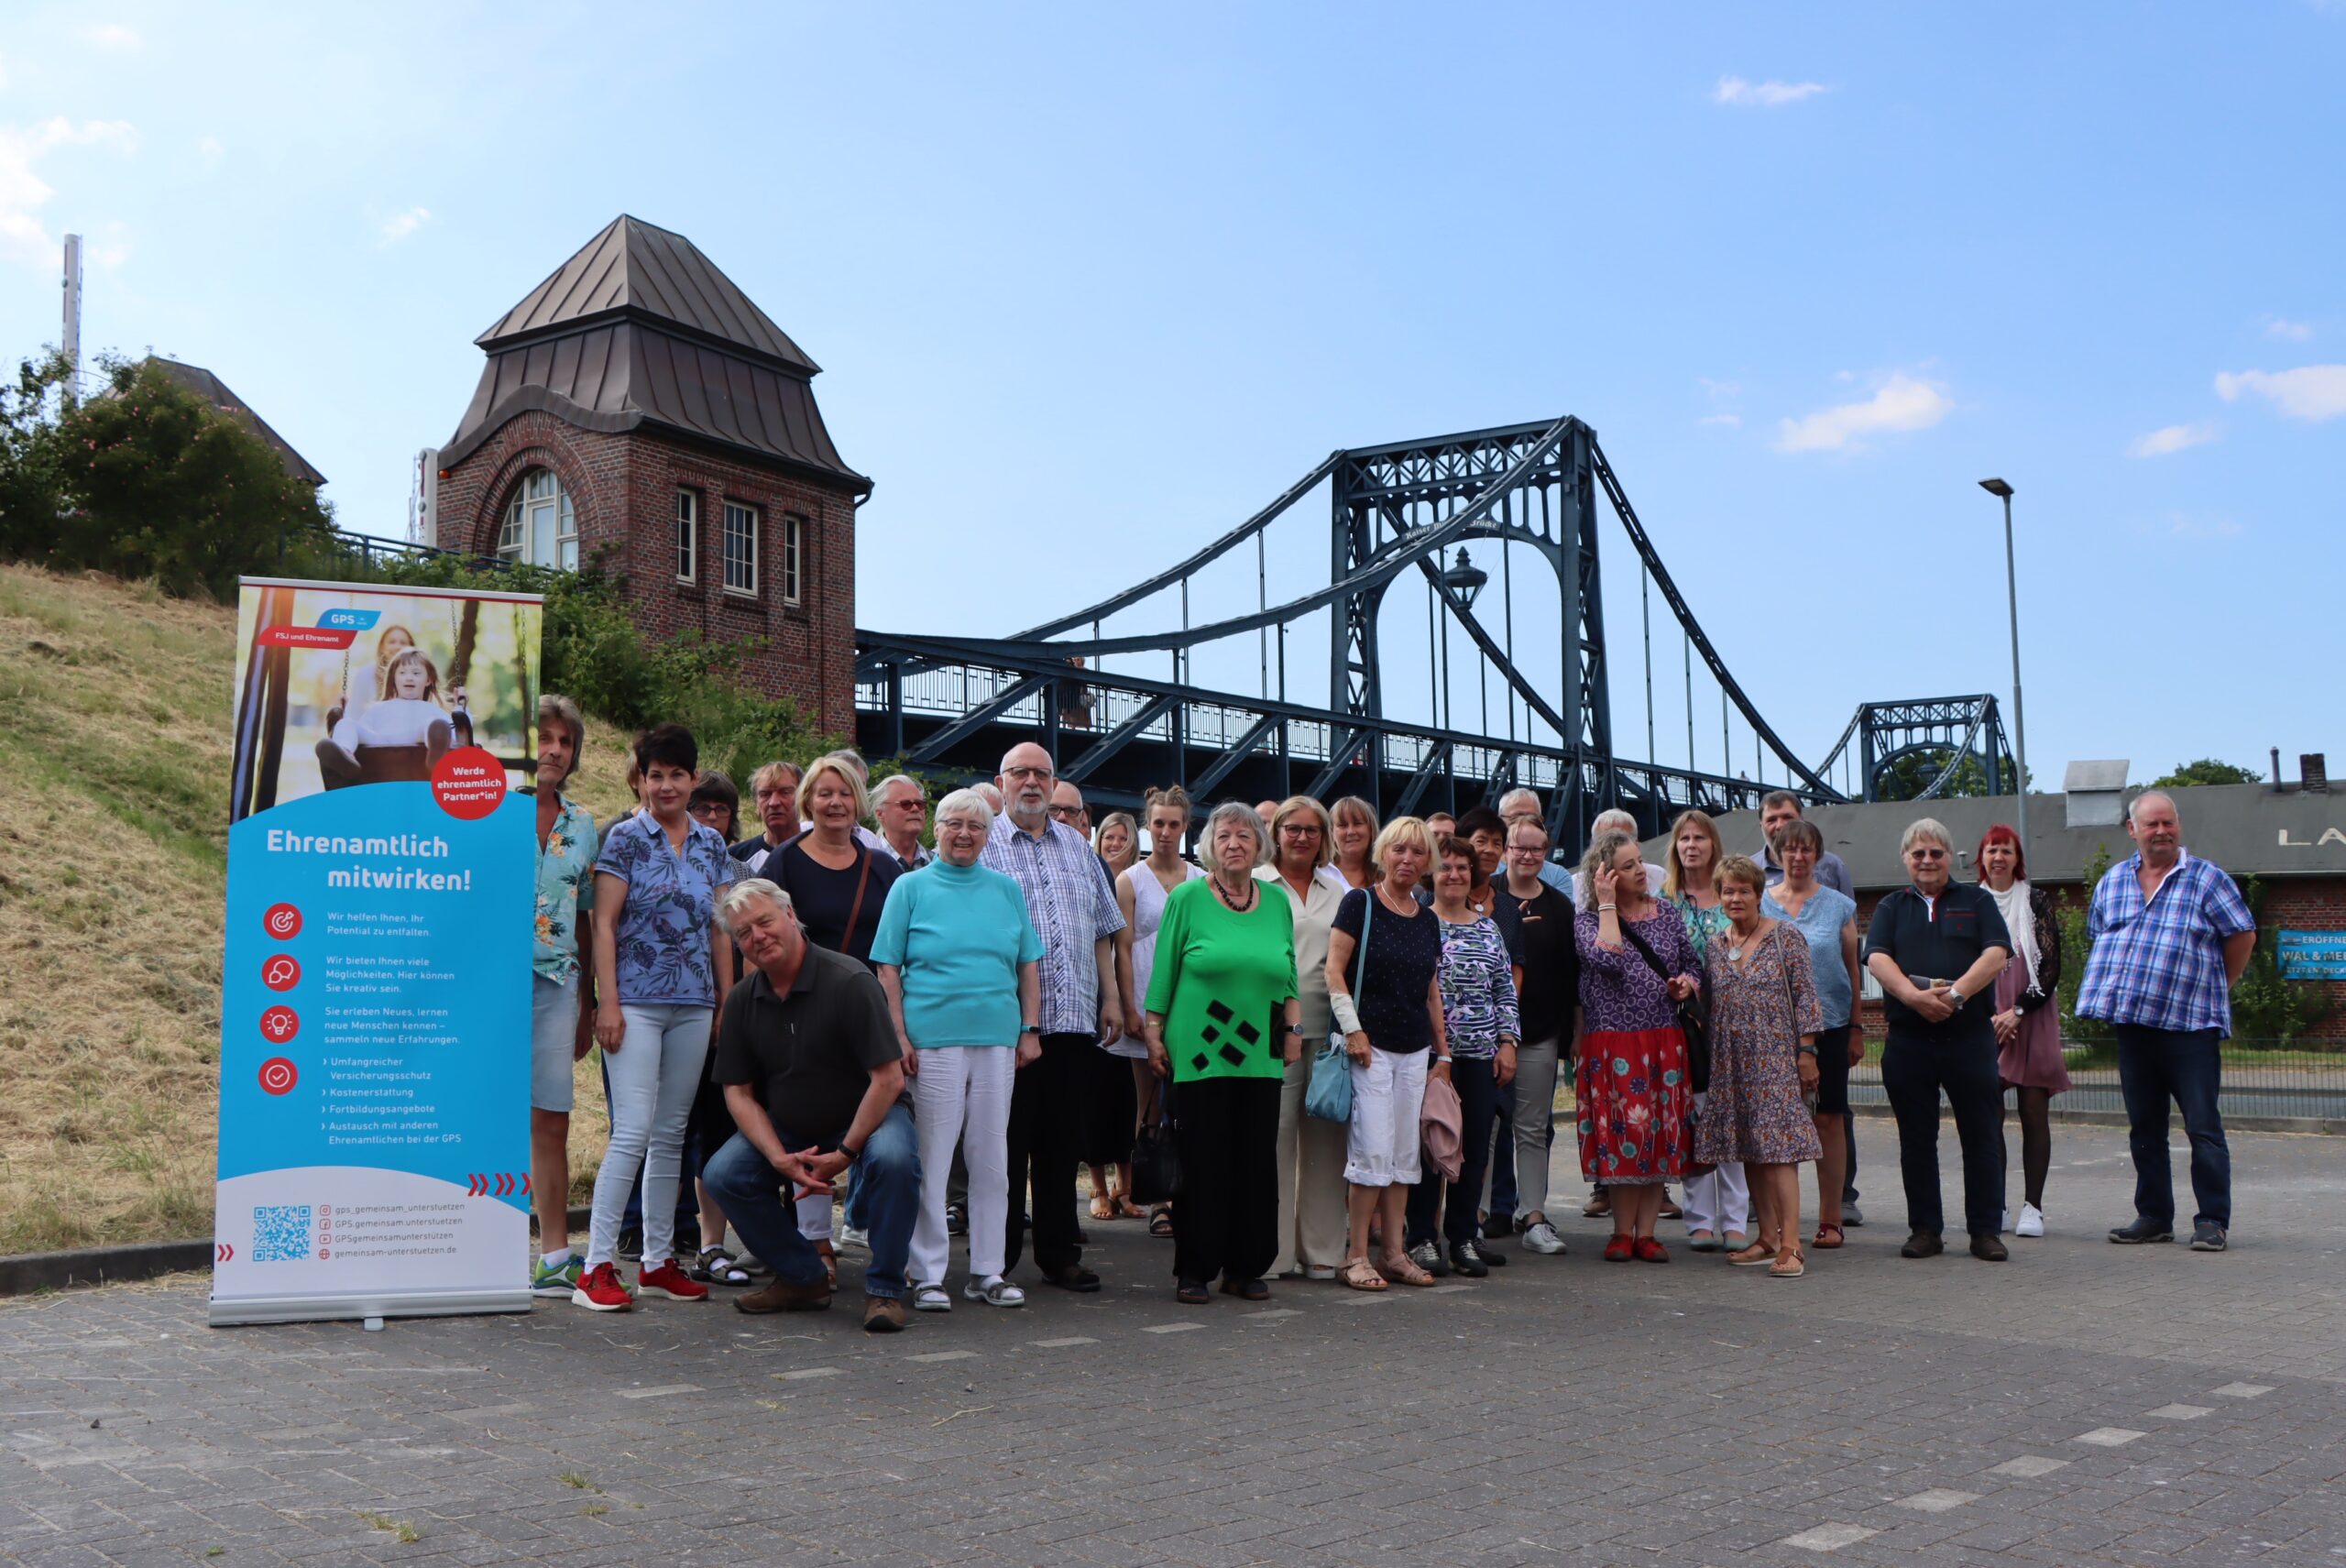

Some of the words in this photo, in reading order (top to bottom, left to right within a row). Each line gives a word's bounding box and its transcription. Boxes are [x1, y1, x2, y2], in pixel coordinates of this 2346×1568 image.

[331, 614, 355, 624] GPS
[275, 631, 289, 640] FSJ
[305, 632, 339, 642] Ehrenamt
[453, 767, 485, 775] Werde
[437, 778, 501, 789] ehrenamtlich
[2278, 828, 2346, 845] LA
[267, 829, 448, 857] Ehrenamtlich
[327, 864, 471, 891] mitwirken!
[327, 912, 344, 921] Wir
[347, 913, 378, 921] helfen
[380, 914, 409, 923] Ihnen,
[411, 914, 425, 922] Ihr
[327, 926, 370, 935] Potential
[387, 927, 432, 937] entfalten.
[2282, 950, 2309, 960] WAL
[2311, 950, 2320, 960] &
[326, 956, 343, 964] Wir
[345, 956, 376, 965] bieten
[378, 957, 404, 965] Ihnen
[407, 957, 430, 965] viele
[325, 970, 395, 980] Möglichkeiten.
[398, 970, 417, 979] Hier
[421, 970, 455, 980] können
[325, 983, 340, 992] Sie
[344, 984, 377, 992] kreativ
[380, 984, 401, 992] sein.
[325, 1007, 340, 1015] Sie
[343, 1007, 379, 1015] erleben
[383, 1007, 414, 1017] Neues,
[418, 1008, 448, 1016] lernen
[351, 1021, 400, 1029] Menschen
[402, 1021, 436, 1029] kennen
[324, 1035, 369, 1044] sammeln
[399, 1035, 460, 1046] Erfahrungen.
[331, 1058, 403, 1068] Umfangreicher
[330, 1071, 431, 1081] Versicherungsschutz
[330, 1089, 413, 1098] Kostenerstattung
[329, 1104, 435, 1114] Fortbildungsangebote
[329, 1122, 379, 1130] Austausch
[329, 1135, 404, 1145] Ehrenamtlichen
[423, 1135, 439, 1143] der
[442, 1134, 461, 1143] GPS
[335, 1203, 465, 1215] gps_gemeinsam_unterstuetzen
[334, 1218, 463, 1229] GPS.gemeinsam.unterstuetzen
[334, 1246, 456, 1259] gemeinsam-unterstuetzen.de
